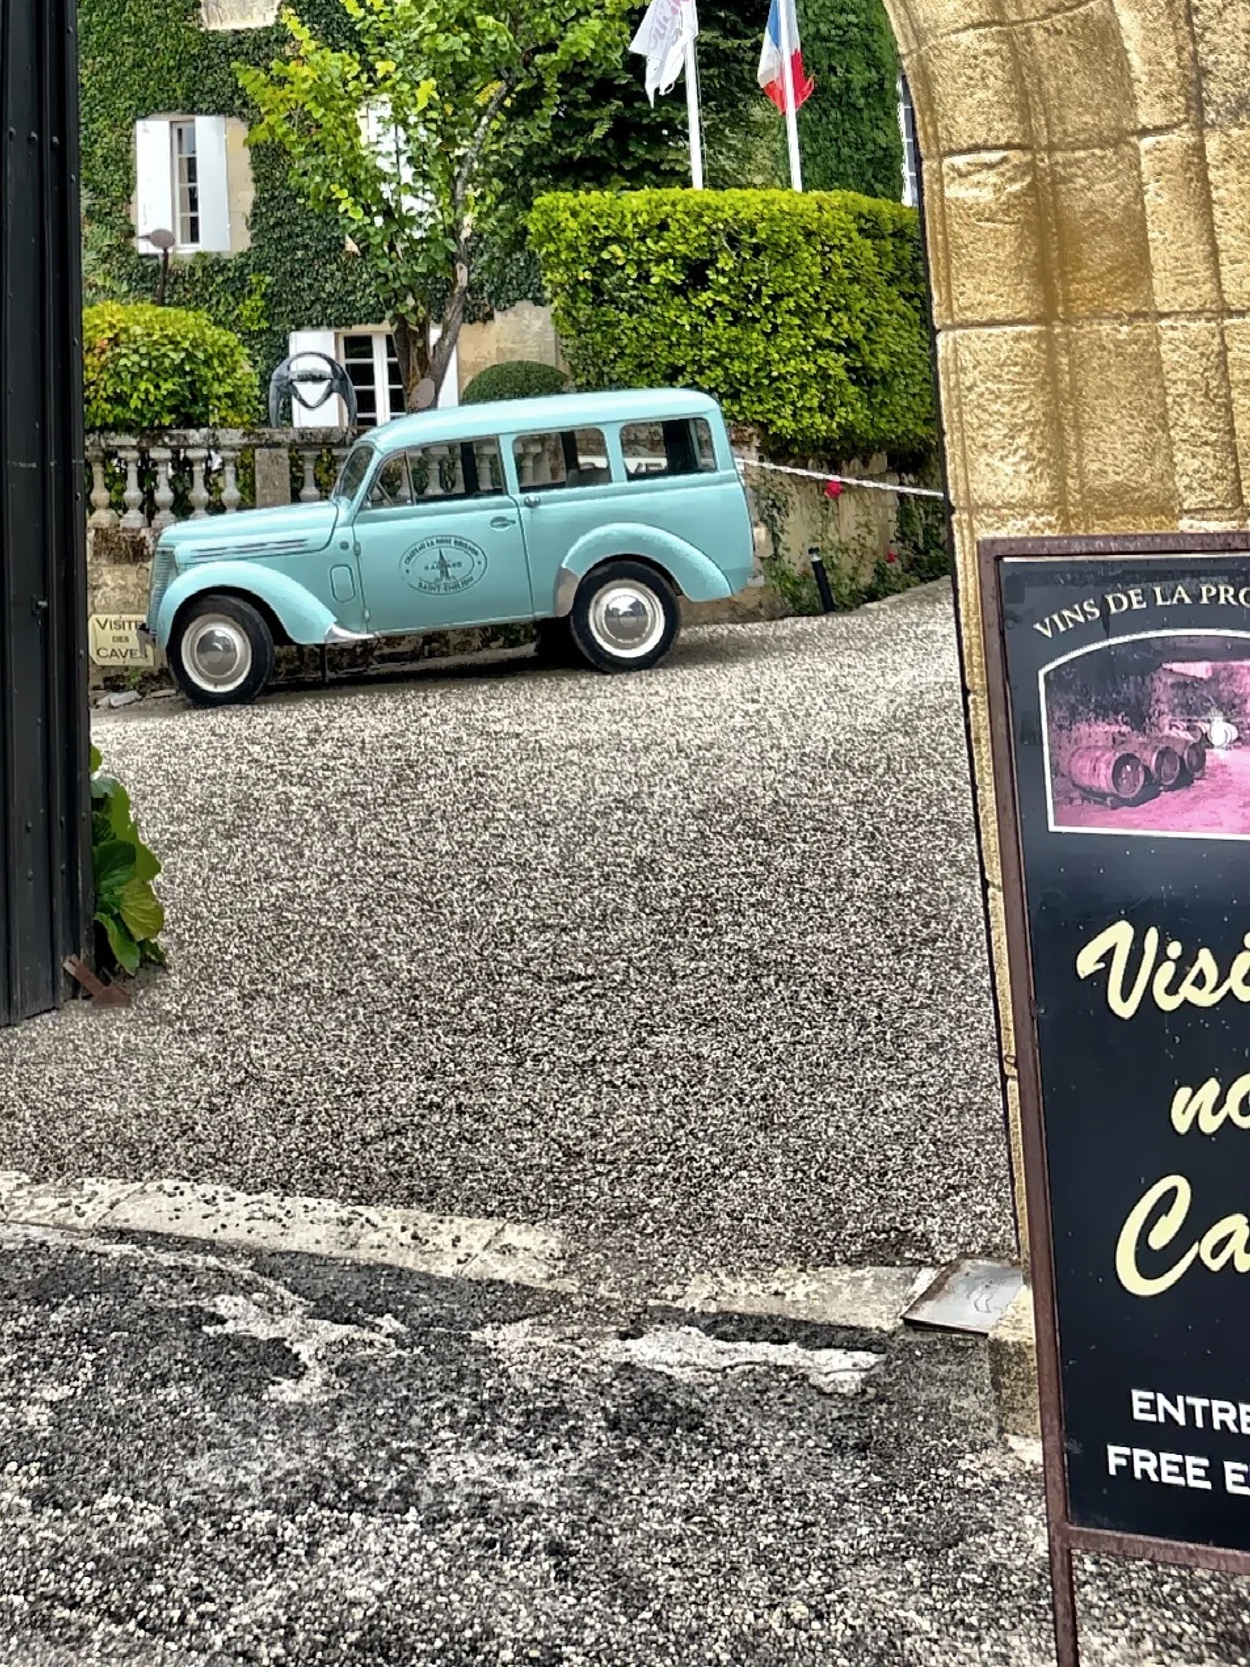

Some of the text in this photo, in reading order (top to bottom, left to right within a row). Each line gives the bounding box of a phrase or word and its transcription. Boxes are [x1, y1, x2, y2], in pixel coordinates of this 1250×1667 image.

[1032, 598, 1102, 639] VINS
[1105, 587, 1148, 615] DE
[1152, 583, 1193, 606] LA
[112, 635, 129, 643] DES
[1115, 1173, 1250, 1297] Ca
[1106, 1444, 1212, 1490] FREE
